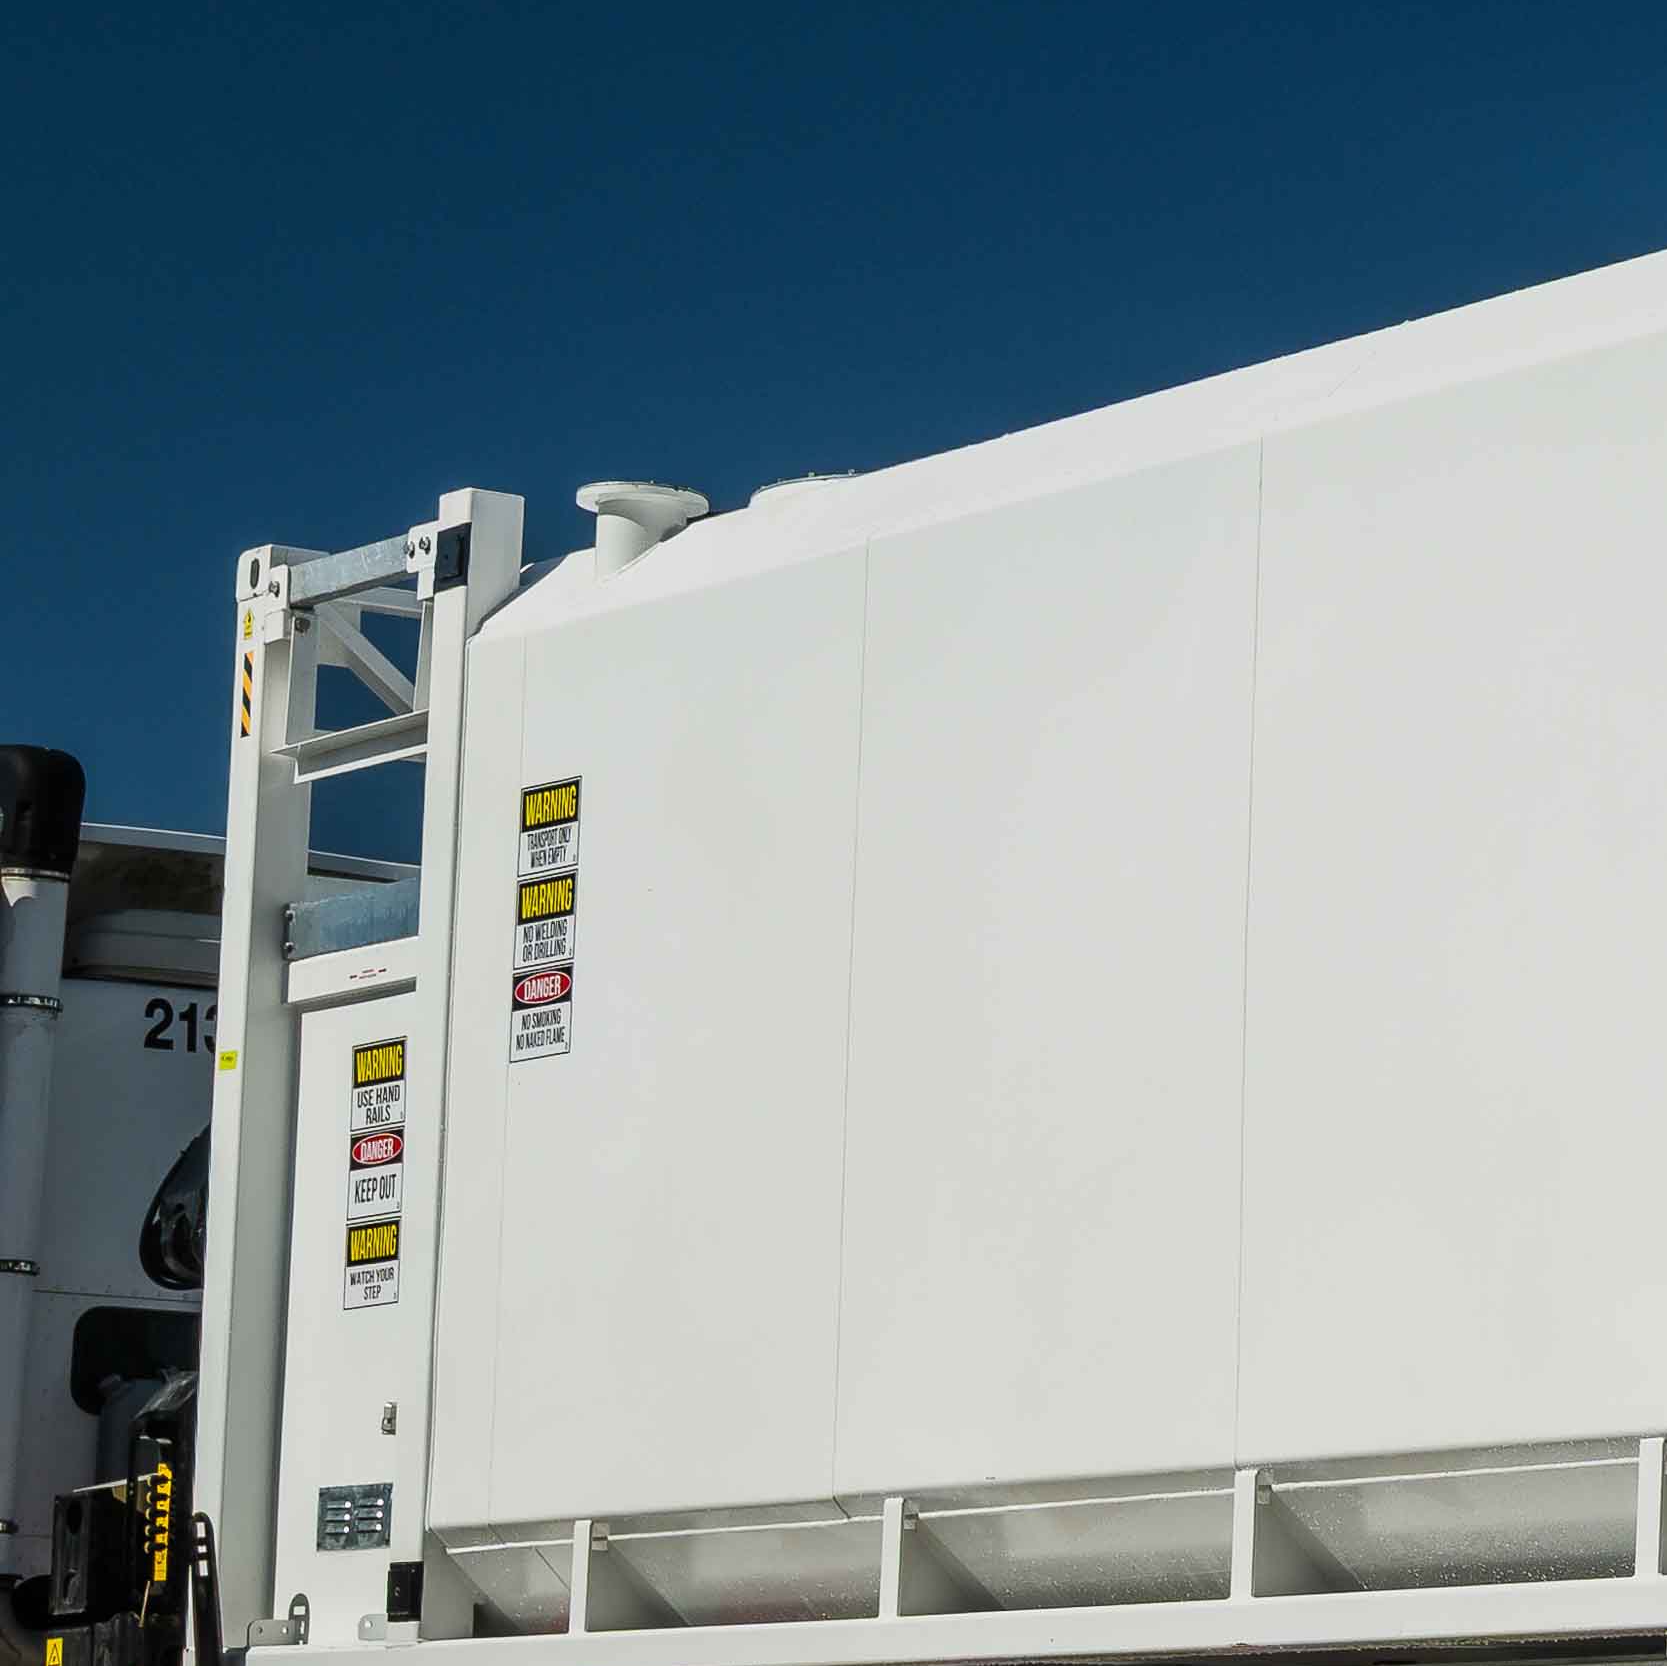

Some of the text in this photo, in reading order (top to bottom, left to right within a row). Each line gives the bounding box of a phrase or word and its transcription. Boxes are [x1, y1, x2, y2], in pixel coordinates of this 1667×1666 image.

[525, 785, 577, 827] WARNING
[522, 878, 573, 919] WARNING
[523, 919, 567, 944] NO WELDING
[522, 937, 566, 962] OR DRILLING
[523, 975, 561, 1001] DANGER
[521, 1008, 561, 1030] NO SMOKING
[516, 1026, 565, 1051] NO NAKED FLAME
[356, 1045, 403, 1083] WARNING
[357, 1085, 400, 1108] USE HAND
[366, 1104, 391, 1125] RAILS
[360, 1138, 394, 1161] DANGER
[355, 1174, 397, 1204] KEEP OUT
[351, 1224, 397, 1261] WARNING
[350, 1267, 394, 1286] WATCH YOUR
[364, 1285, 381, 1300] STEP
